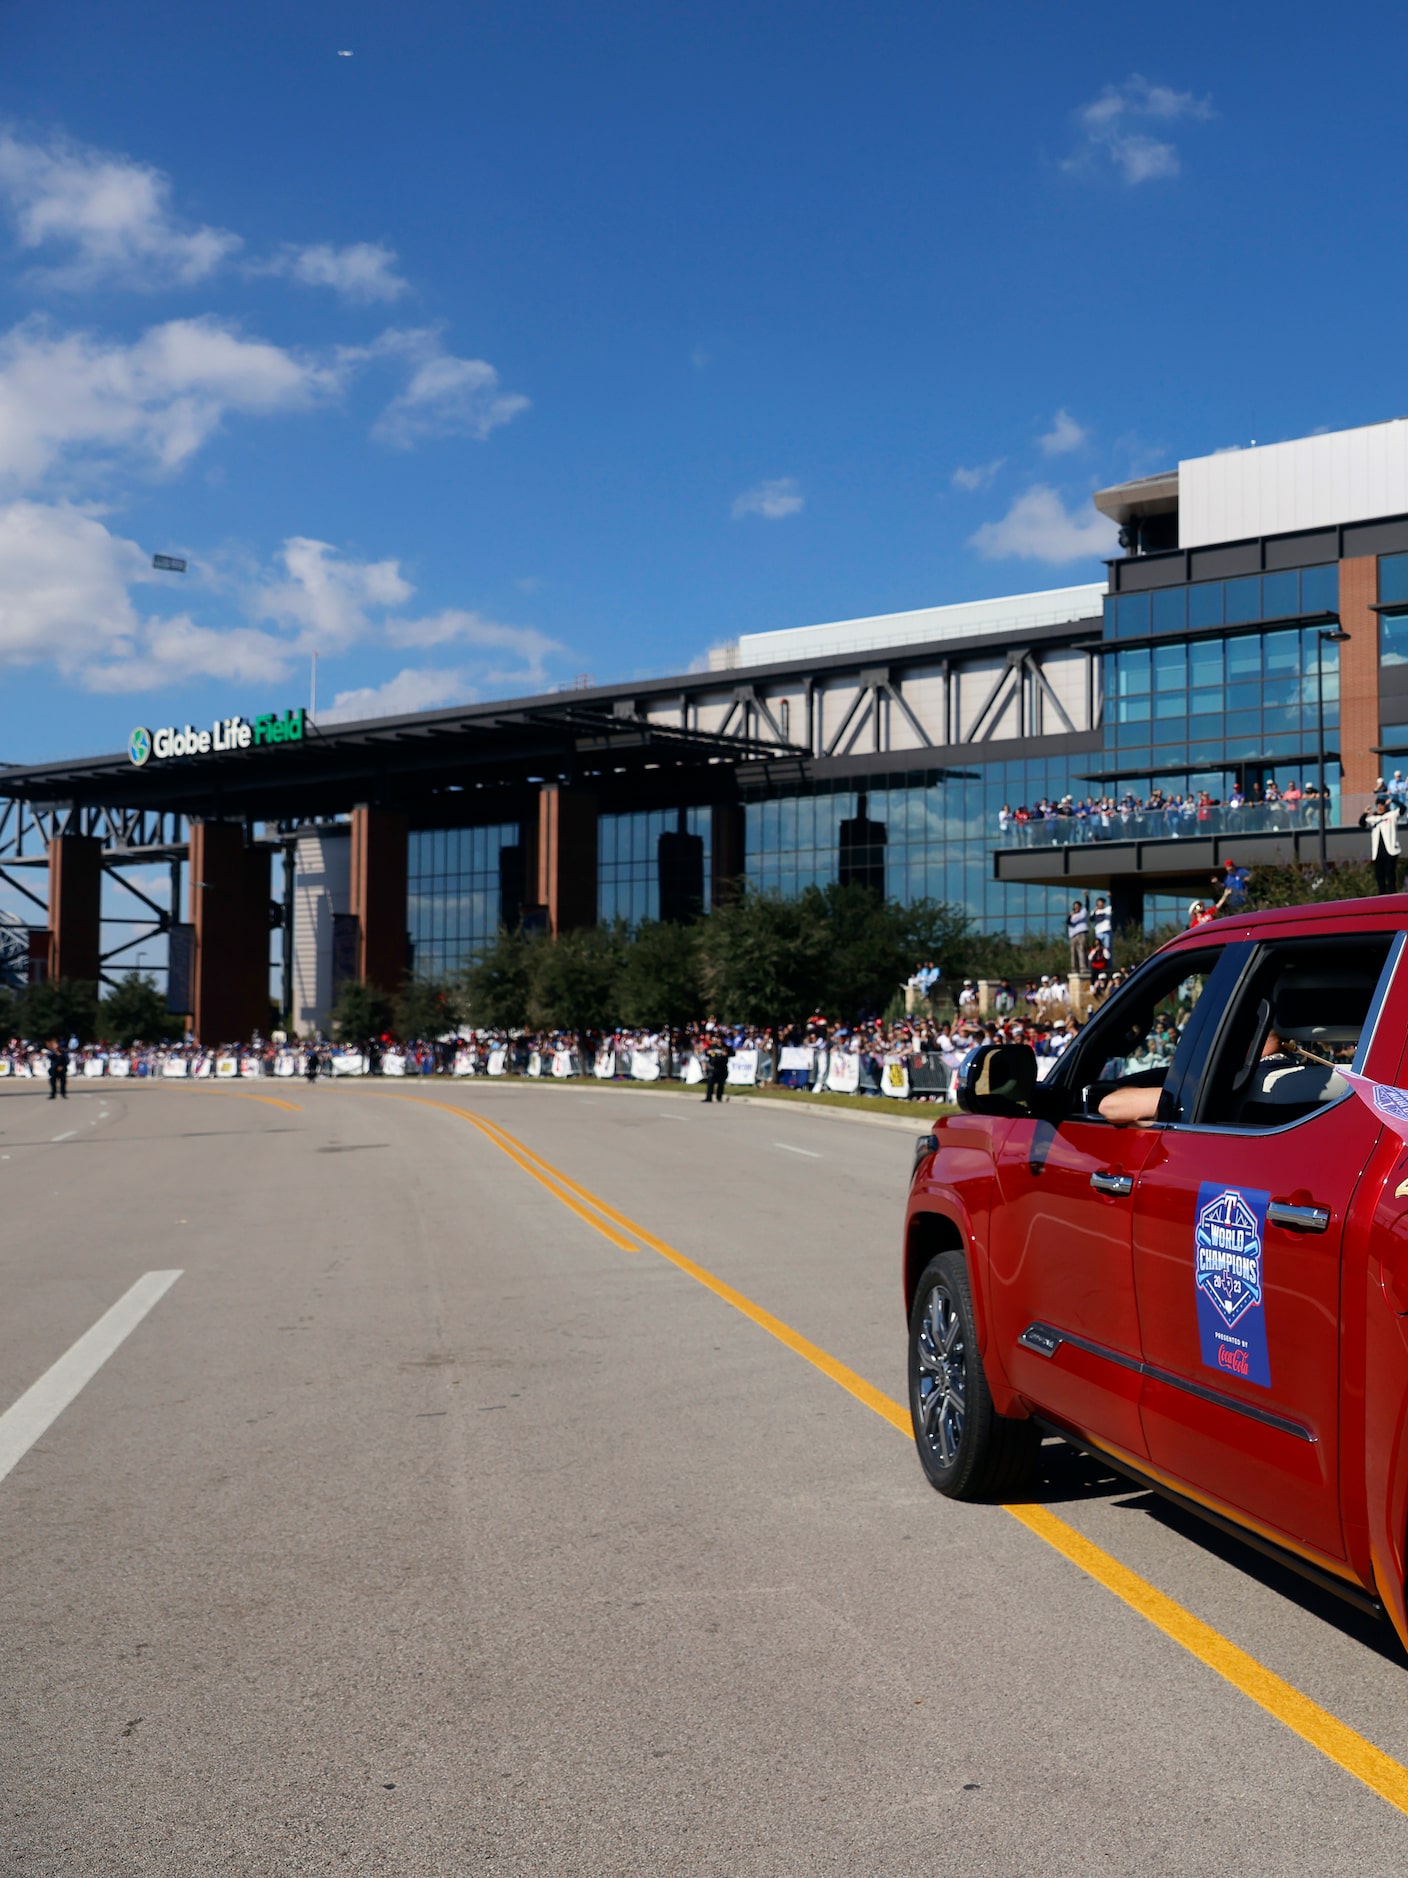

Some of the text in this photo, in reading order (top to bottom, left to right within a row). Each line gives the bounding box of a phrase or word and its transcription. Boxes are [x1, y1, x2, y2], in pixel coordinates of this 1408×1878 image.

[153, 707, 304, 759] Globe Life Field
[1210, 1223, 1245, 1252] WORLD
[1199, 1247, 1257, 1284] CHAMPIONS
[1214, 1331, 1249, 1348] PRESENTED BY
